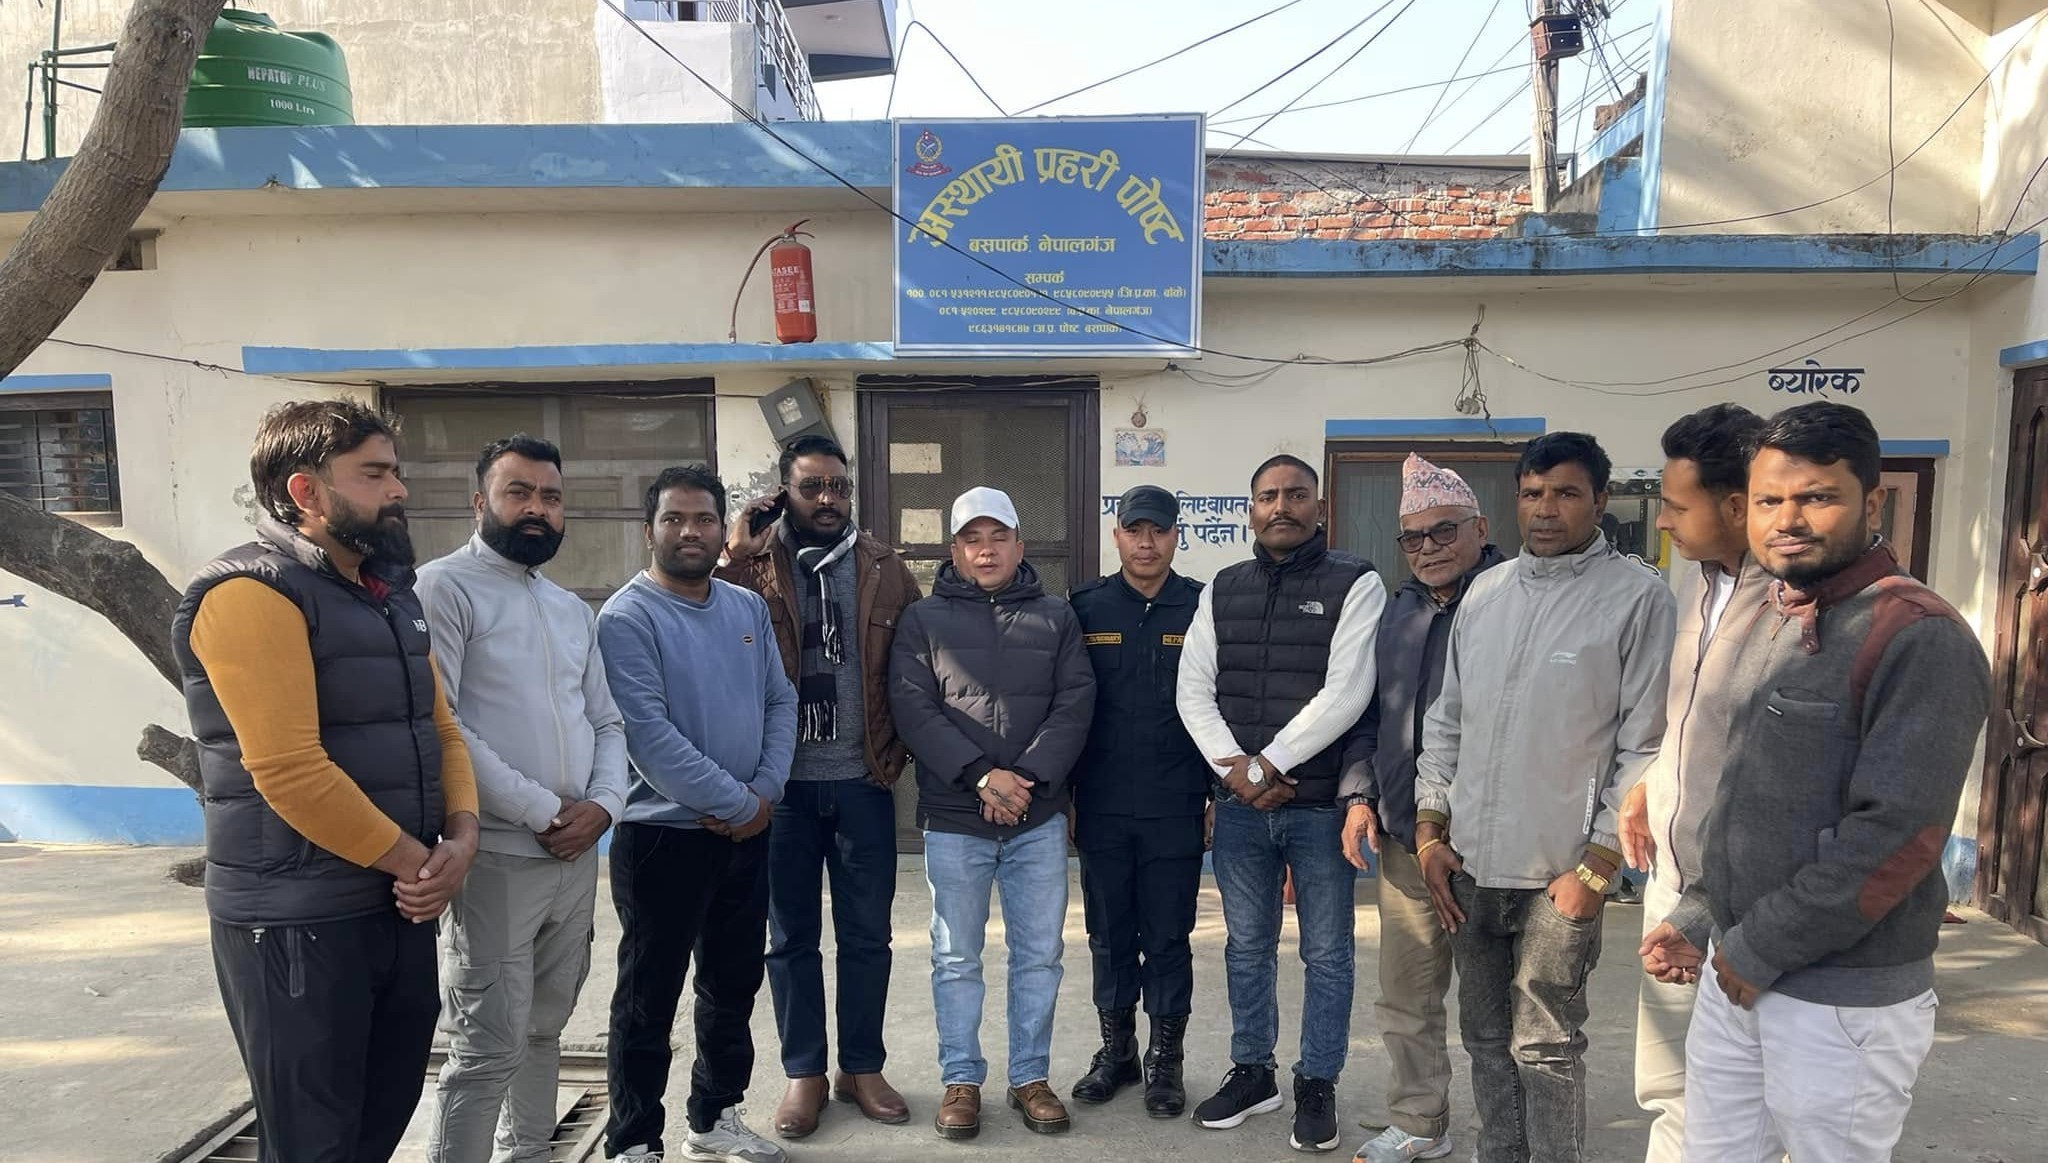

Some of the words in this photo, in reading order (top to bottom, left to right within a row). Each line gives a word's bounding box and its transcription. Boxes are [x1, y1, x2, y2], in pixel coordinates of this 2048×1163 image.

[297, 74, 327, 92] PLUS
[270, 98, 293, 110] 1000
[907, 143, 1025, 248] अस्थायी
[1033, 147, 1121, 192] प्रहरी
[1116, 173, 1185, 246] पोष्ट
[1038, 234, 1116, 252] नेपालगंज
[1024, 270, 1065, 284] सम्पर्क
[906, 288, 924, 299] १००
[929, 288, 947, 298] ०८१
[939, 307, 957, 316] ०८१
